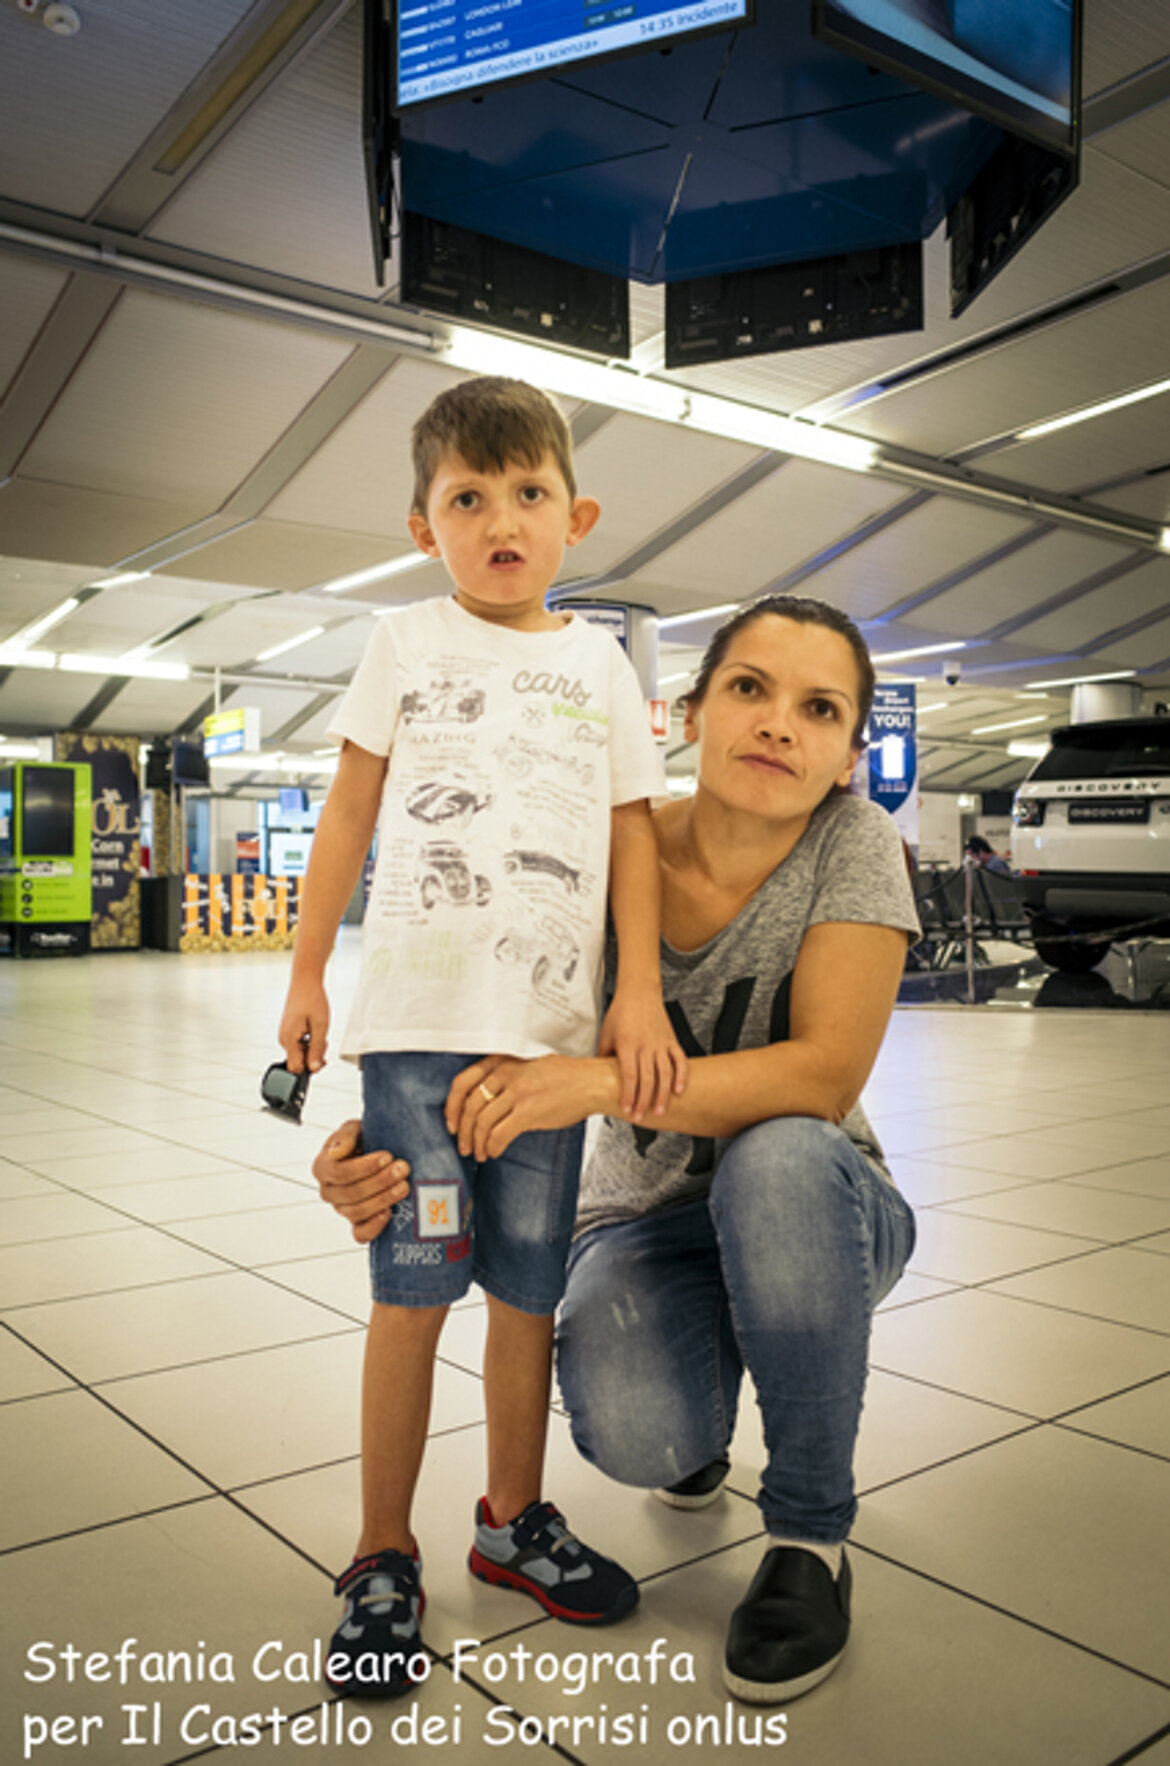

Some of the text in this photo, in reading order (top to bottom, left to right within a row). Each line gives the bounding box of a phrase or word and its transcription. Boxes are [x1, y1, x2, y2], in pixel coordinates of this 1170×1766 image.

[511, 670, 593, 708] cars
[874, 713, 912, 728] YOU!
[1056, 782, 1160, 793] DISCOVERY
[1070, 807, 1146, 818] DISCOVERY
